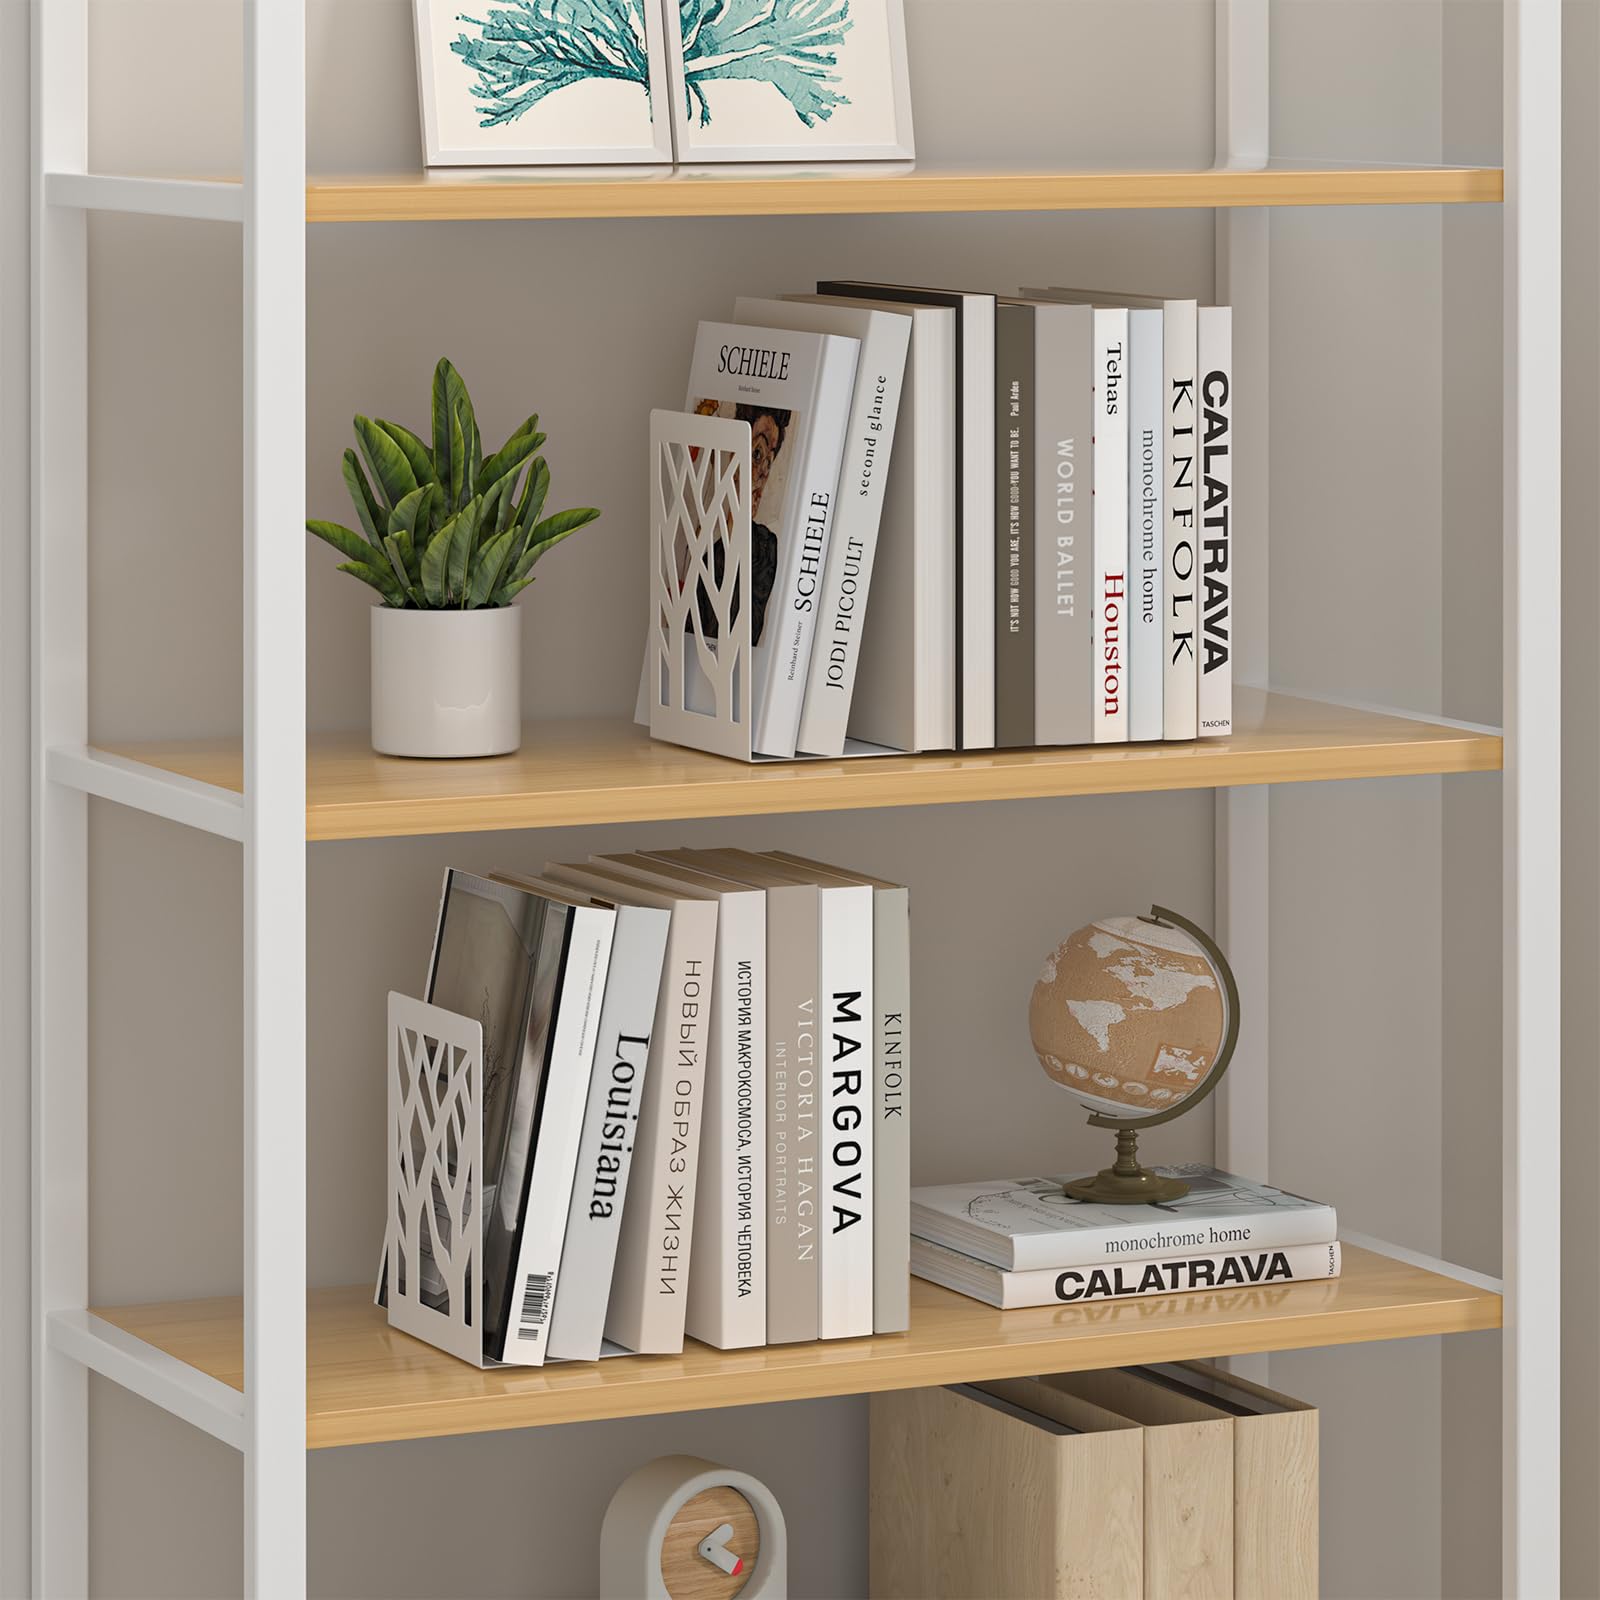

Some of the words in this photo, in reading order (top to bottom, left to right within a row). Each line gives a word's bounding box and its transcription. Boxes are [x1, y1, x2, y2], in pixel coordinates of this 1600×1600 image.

[718, 345, 790, 380] SCHIELE
[1010, 381, 1019, 399] Arden
[1106, 341, 1122, 416] Tehas
[867, 376, 886, 431] glance
[1010, 403, 1019, 416] Paul
[860, 438, 876, 496] second
[1010, 440, 1020, 448] TO
[1010, 451, 1020, 469] WANT
[1010, 505, 1020, 520] HOW
[1057, 439, 1074, 523] WORLD
[1143, 430, 1157, 560] monochrome
[795, 492, 830, 613] SCHIELE
[1010, 521, 1020, 535] IT'S
[1173, 379, 1193, 665] KINFOLK
[1202, 370, 1229, 675] CALATRAVA
[834, 536, 864, 633] PICOULT
[1010, 553, 1020, 567] YOU
[1010, 568, 1020, 586] GOOD
[1057, 536, 1074, 616] BALLET
[1010, 588, 1020, 603] HOW
[1010, 604, 1020, 618] NOT
[1010, 619, 1020, 633] IT'S
[1143, 569, 1157, 622] home
[787, 647, 799, 681] Reinhard
[793, 621, 803, 647] Steiner
[826, 641, 847, 689] JODI
[1104, 571, 1124, 717] Houston
[678, 960, 702, 1067] НОВЫЙ
[738, 961, 752, 1025] ИСТОРИЯ
[735, 1030, 752, 1152] МАКРОКОСМОСА,
[776, 1042, 786, 1122] INTERIOR
[798, 999, 813, 1141] VICTORIA
[885, 1013, 902, 1119] KINFOLK
[589, 1031, 650, 1221] Louisiana
[670, 1079, 692, 1174] ОБРАЗ
[833, 992, 861, 1234] MARGOVA
[738, 1155, 752, 1221] ИСТОРИЯ
[776, 1132, 786, 1224] PORTRAITS
[798, 1157, 813, 1260] HAGAN
[660, 1184, 684, 1295] ЖИЗНИ
[738, 1224, 752, 1298] ЧЕЛОВЕКА
[1105, 1231, 1205, 1253] monochrome
[1210, 1227, 1250, 1243] home
[1327, 1244, 1335, 1276] TASCHEN
[1055, 1252, 1294, 1301] CALATRAVA
